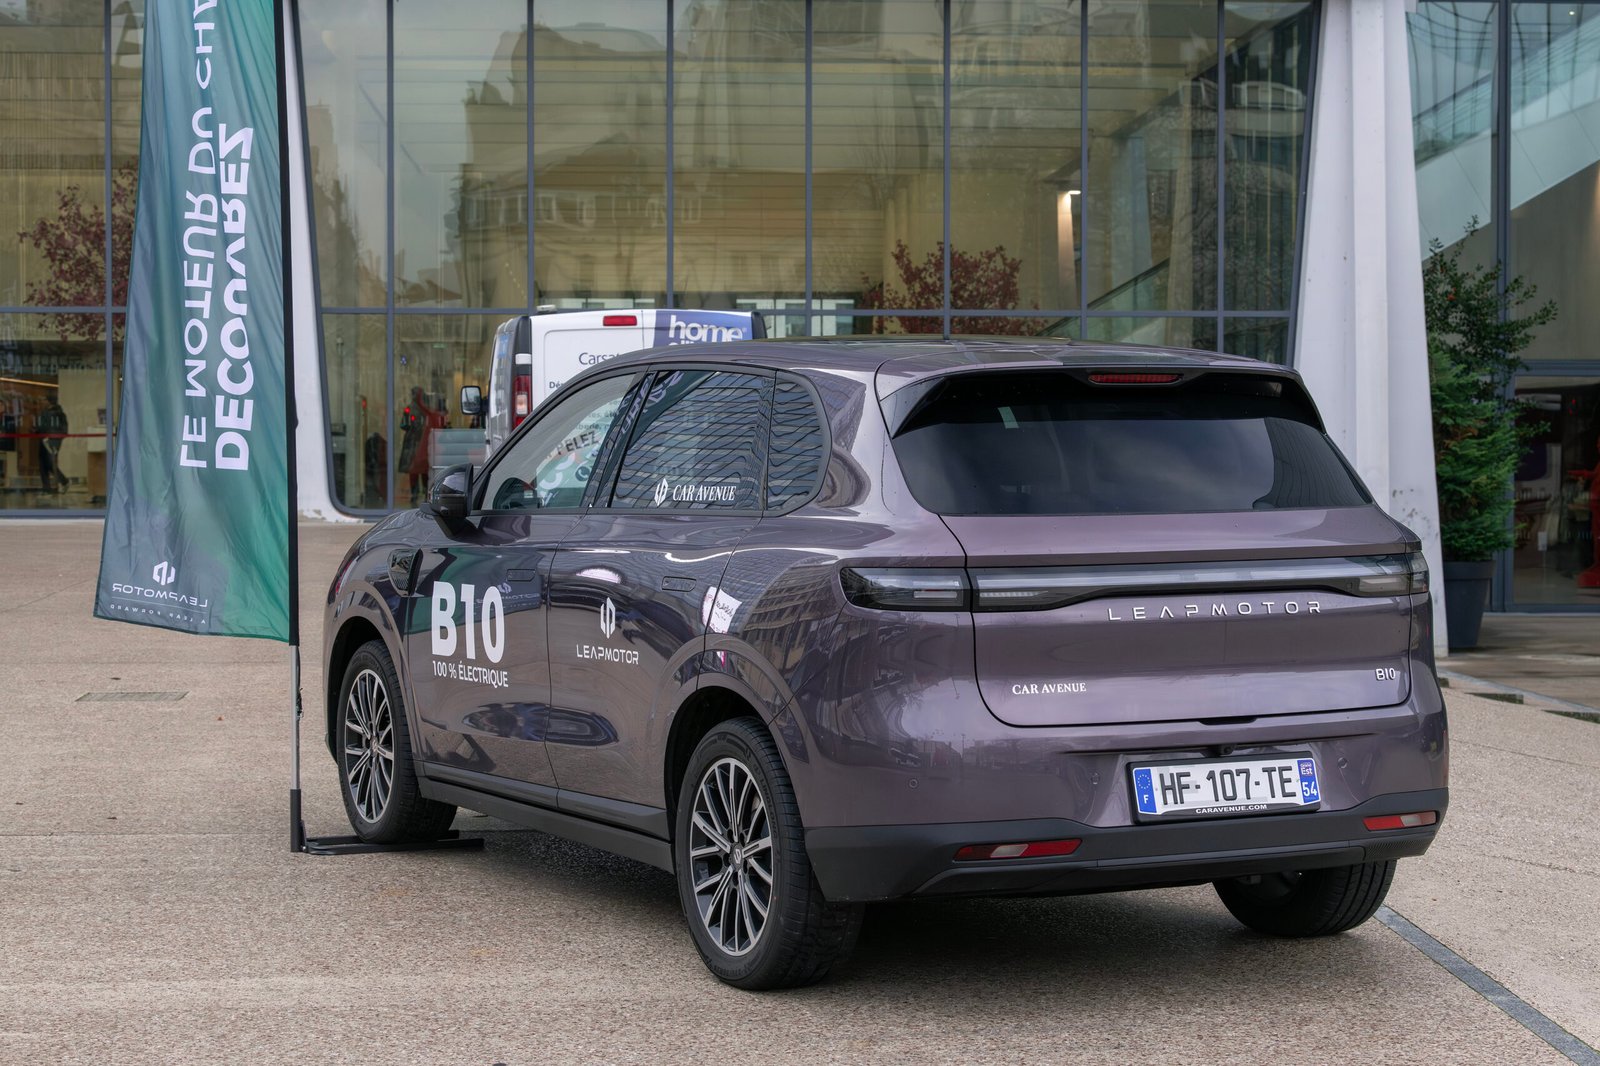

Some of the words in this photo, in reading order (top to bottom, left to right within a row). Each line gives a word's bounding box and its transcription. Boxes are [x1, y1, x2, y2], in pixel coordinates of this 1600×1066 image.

[668, 314, 743, 342] home
[672, 484, 695, 501] CAR
[695, 484, 737, 501] AVENUE
[1107, 600, 1322, 621] LEAPMOTOR
[431, 580, 505, 664] B10
[576, 643, 639, 665] LEAPMOTOR
[432, 660, 448, 678] 100
[448, 662, 457, 679] %
[458, 660, 509, 689] ÉLECTRIQUE
[1375, 667, 1396, 681] B10
[1012, 683, 1039, 695] CAR
[1041, 682, 1087, 694] AVENUE
[1301, 781, 1318, 797] 54
[1143, 794, 1149, 804] F
[1195, 803, 1268, 814] CARAVENUE.COM
